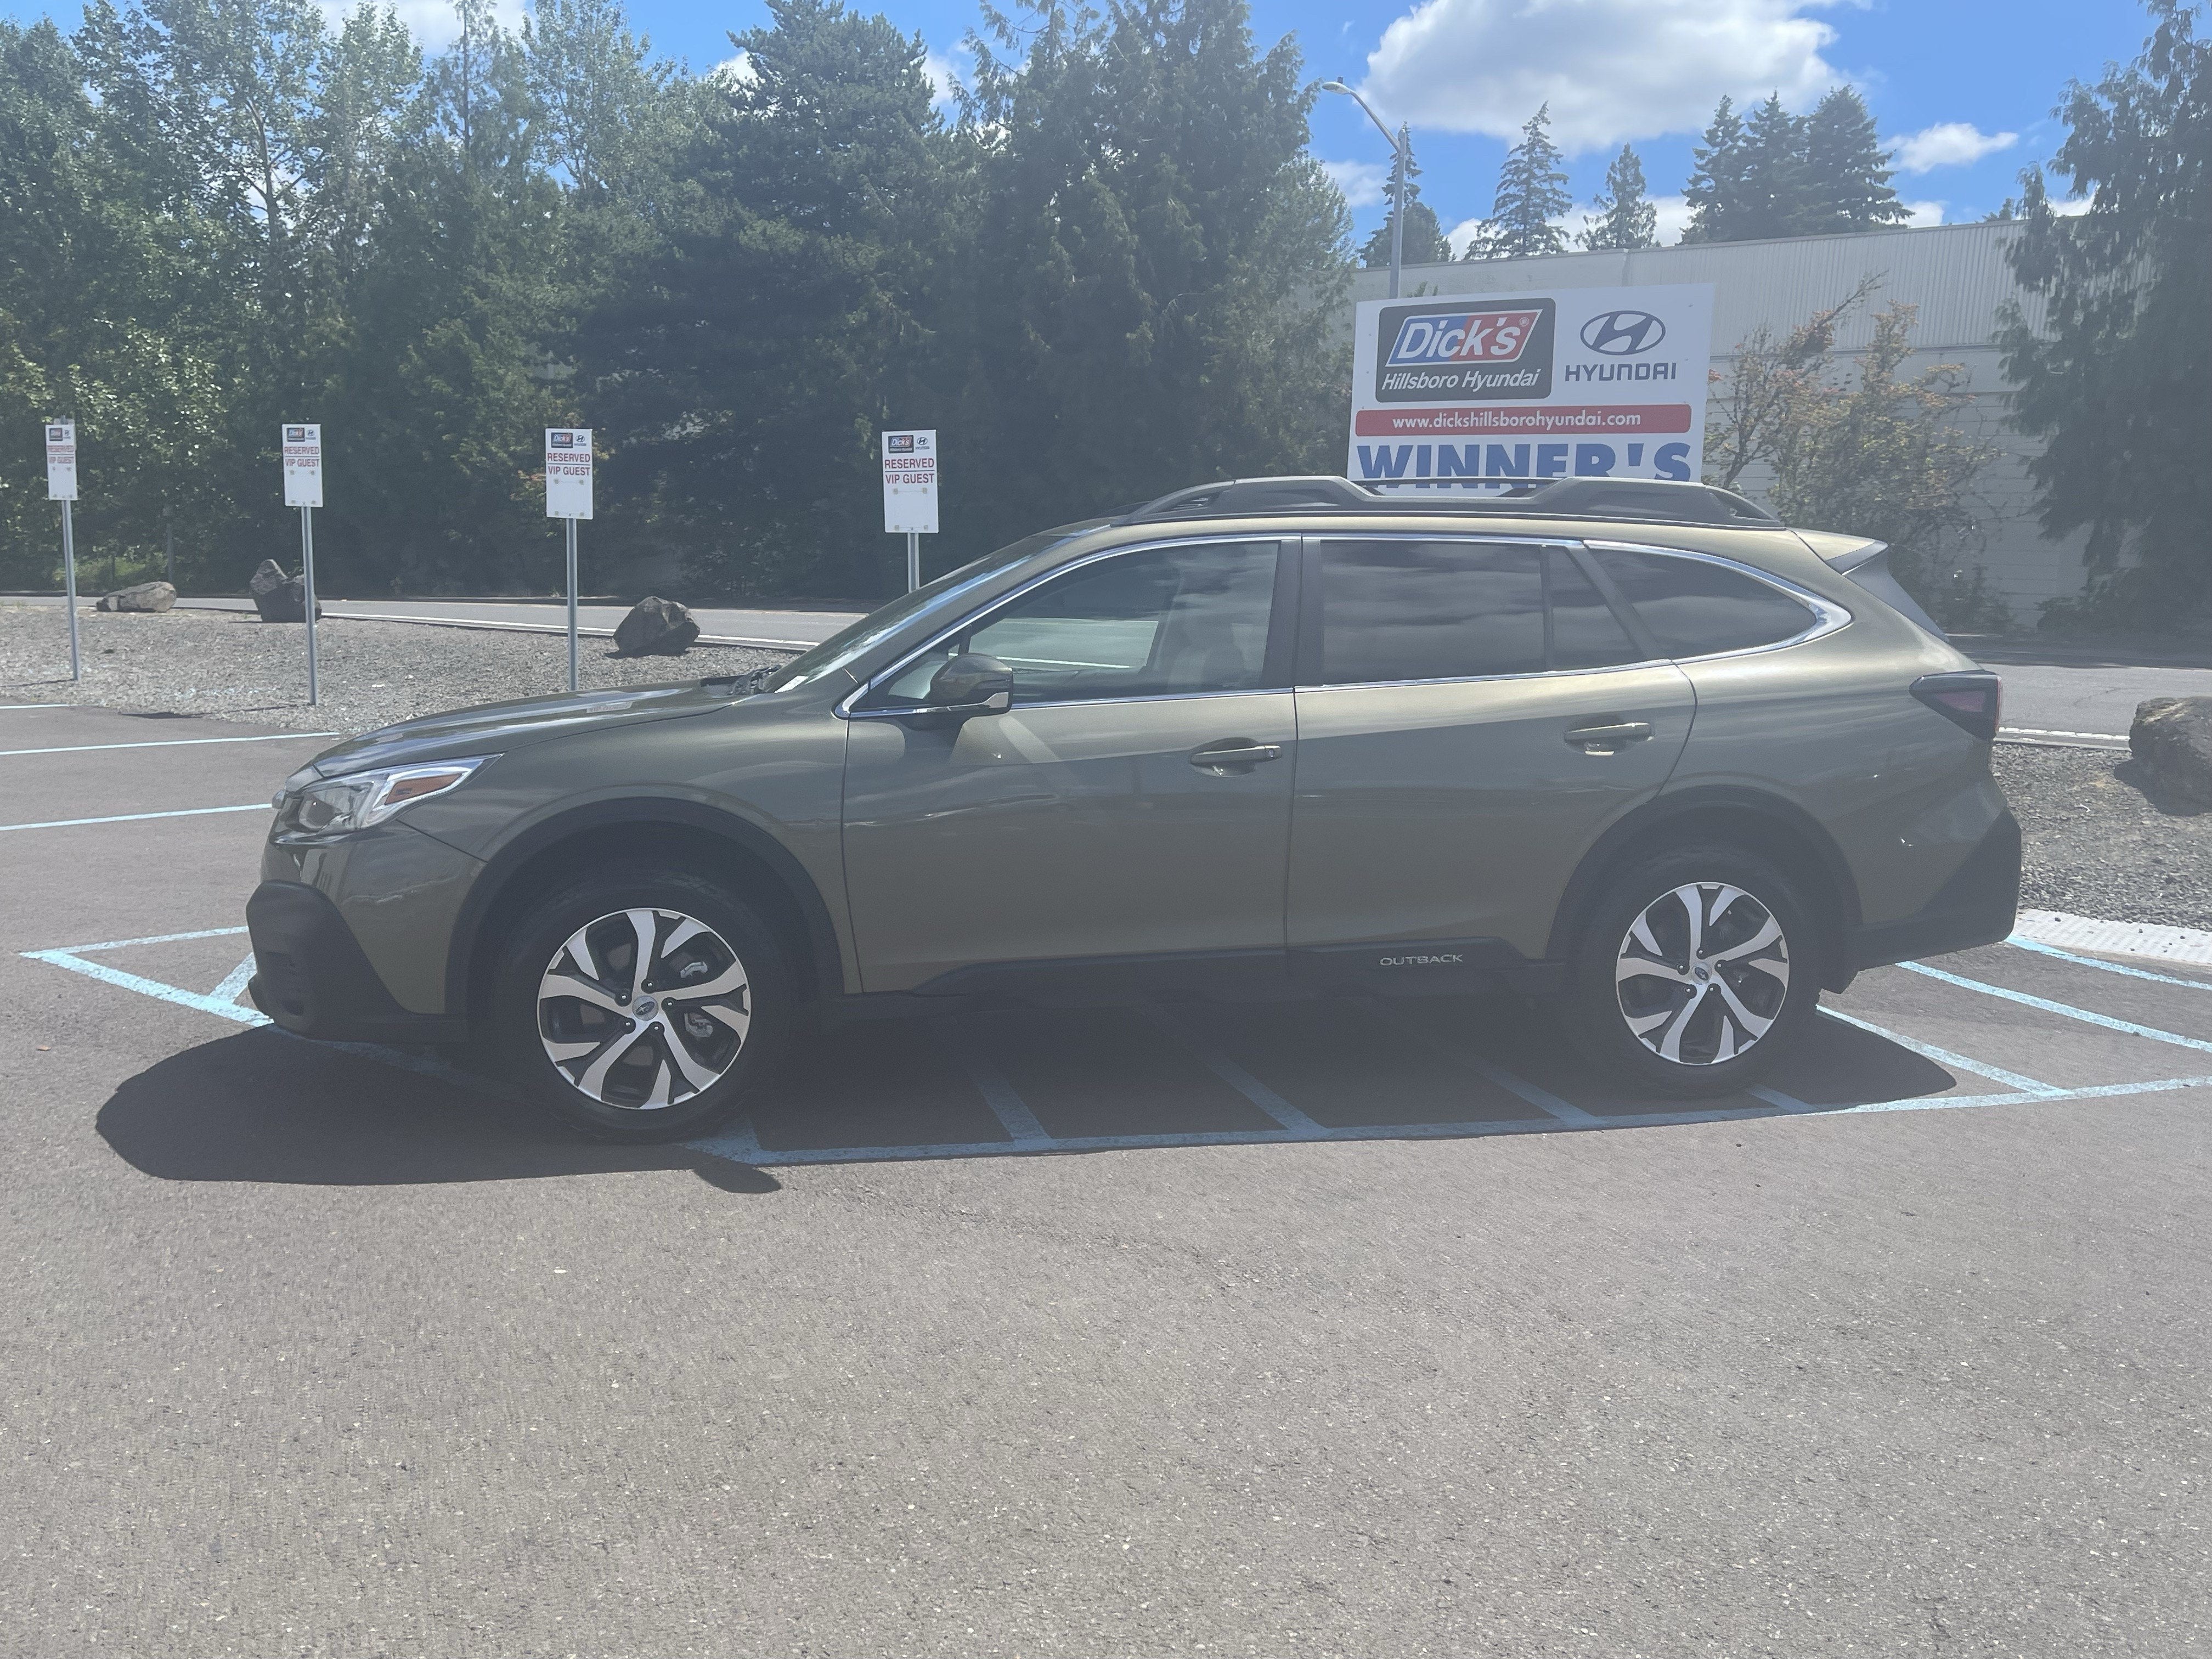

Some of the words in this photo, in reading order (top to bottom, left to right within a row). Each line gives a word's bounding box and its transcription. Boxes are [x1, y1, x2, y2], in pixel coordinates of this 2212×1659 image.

[1397, 317, 1521, 359] Dick's
[1565, 362, 1677, 382] HYUNDAI
[1381, 371, 1459, 390] Hillsboro
[1462, 368, 1542, 393] Hyundai
[1392, 410, 1641, 431] www.dickshillsborohyundai.com
[284, 446, 320, 455] RESERVED
[297, 459, 320, 467] GUEST
[547, 453, 591, 462] RESERVED
[884, 458, 935, 469] RESERVED
[1356, 442, 1691, 489] WINNER'S
[548, 466, 561, 475] VIP
[563, 466, 591, 476] GUEST
[885, 474, 900, 484] VIP
[902, 473, 935, 484] GUEST
[1379, 954, 1464, 966] OUTBACK
